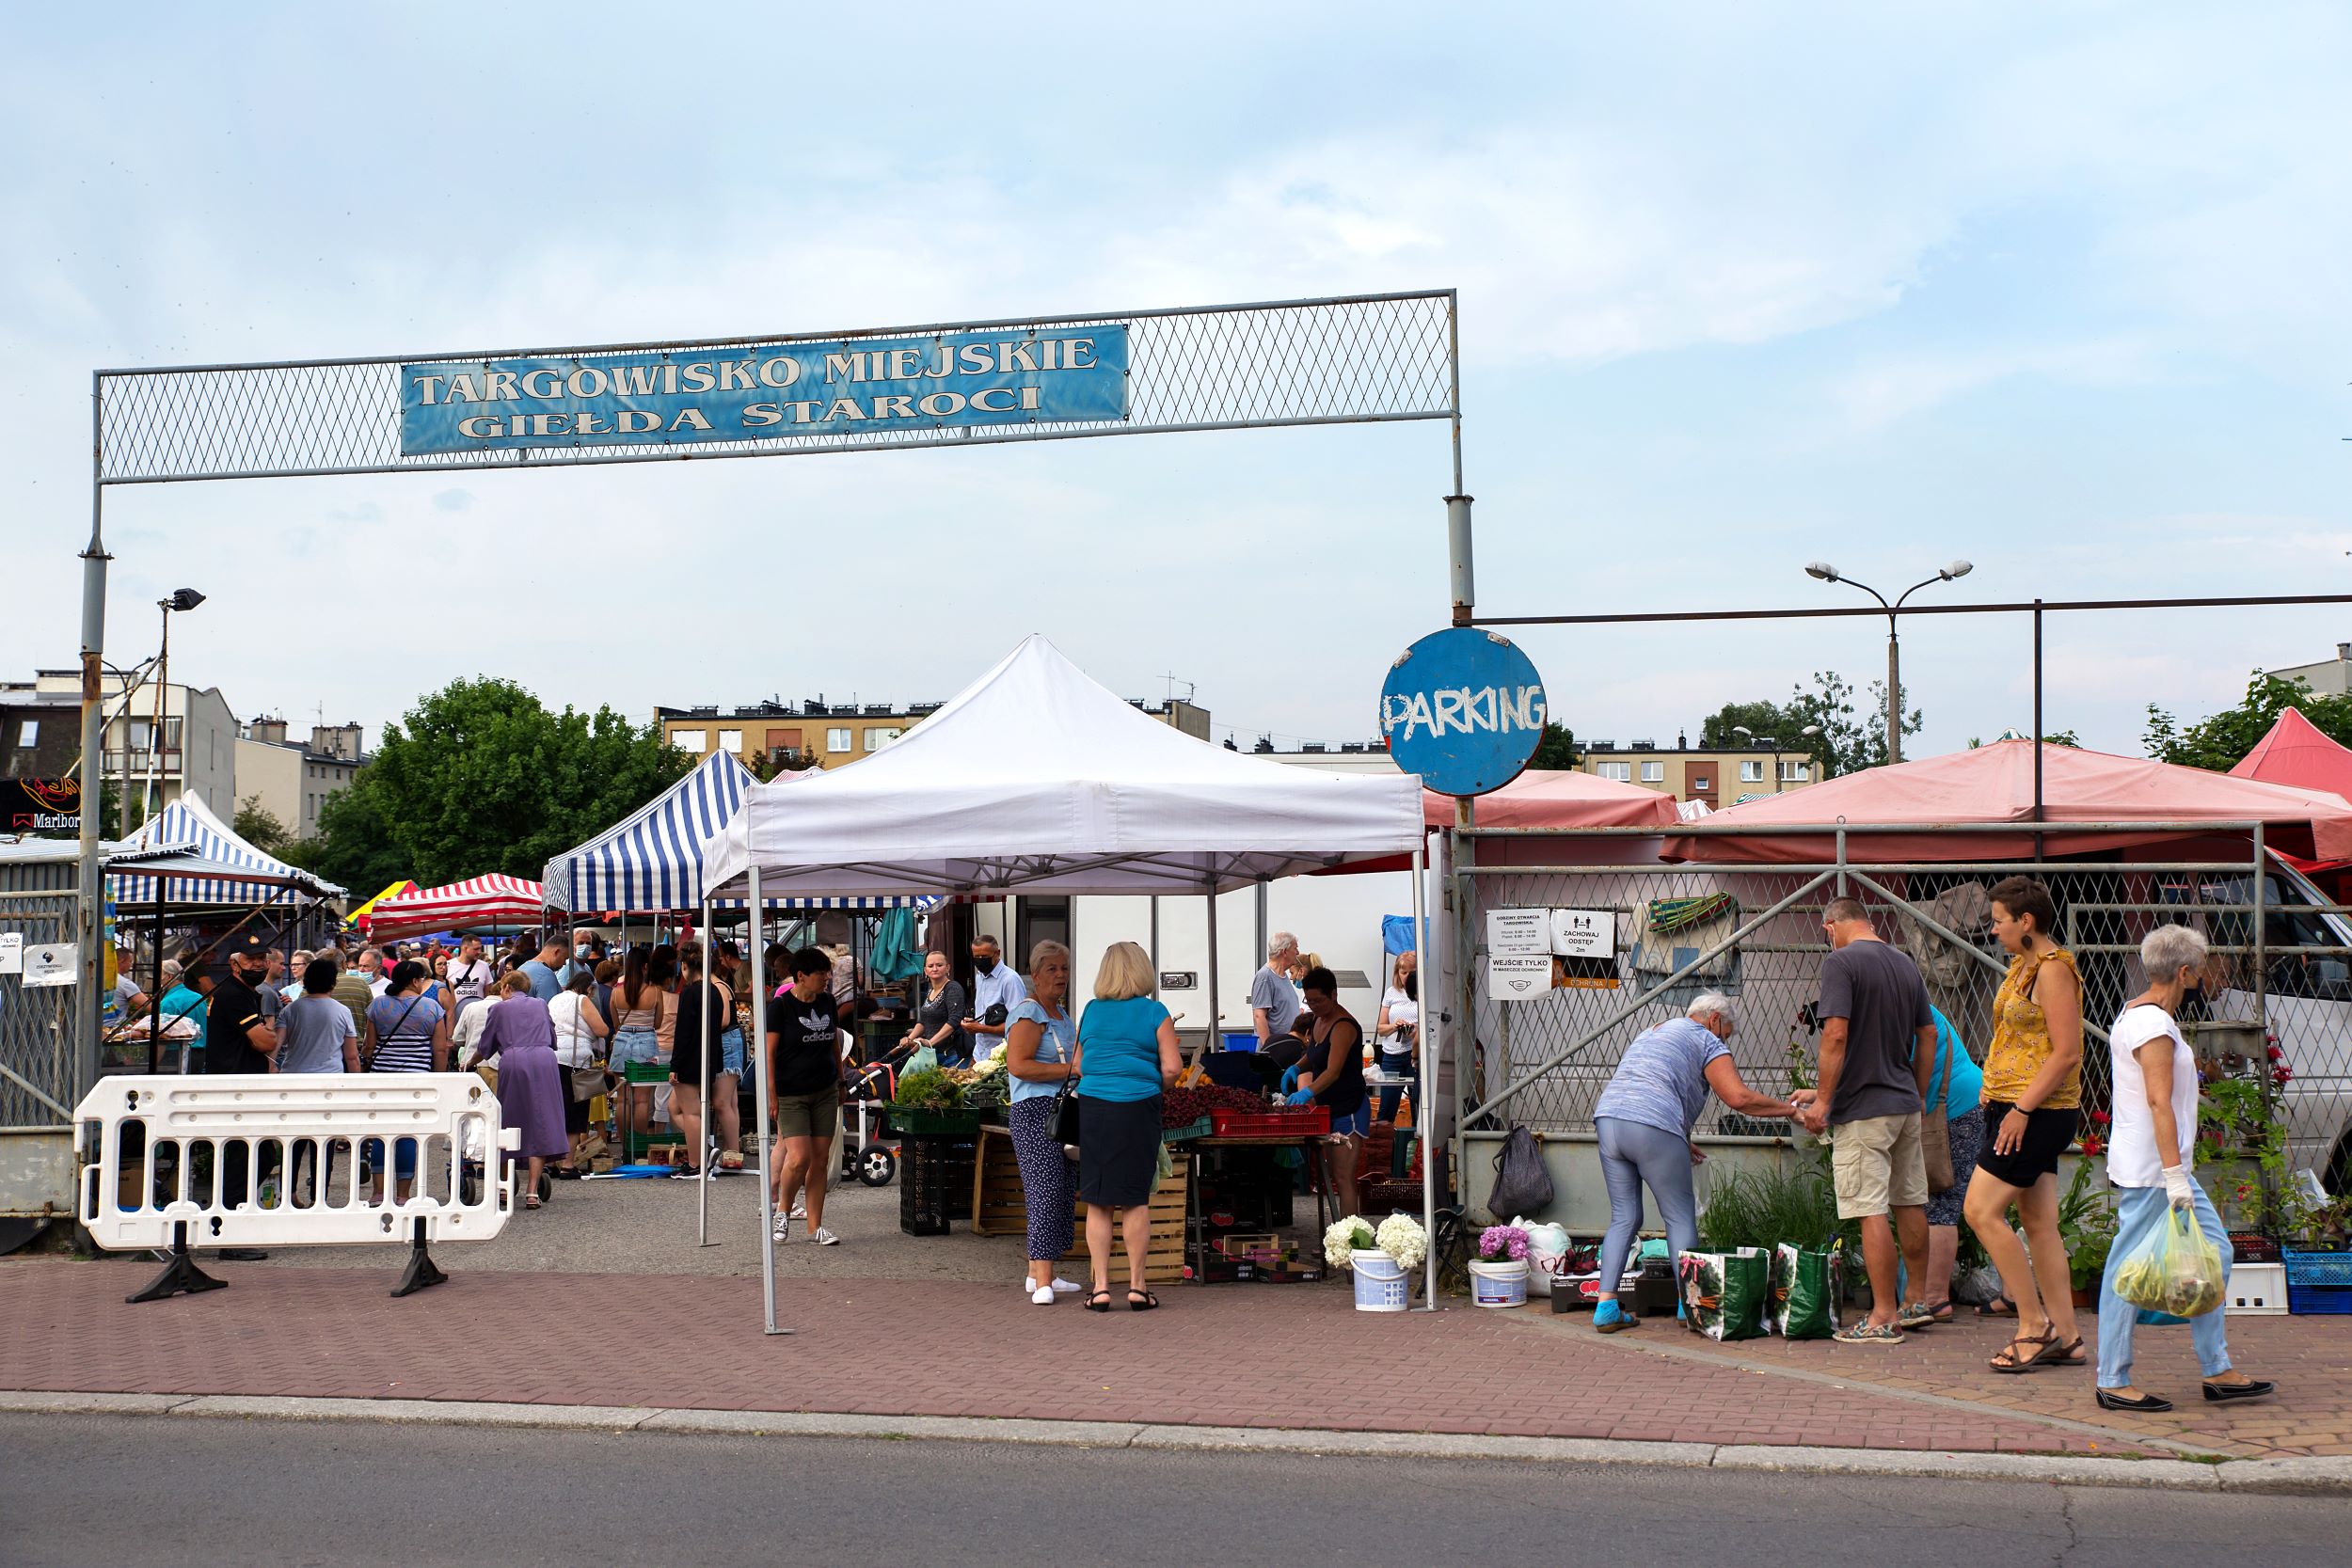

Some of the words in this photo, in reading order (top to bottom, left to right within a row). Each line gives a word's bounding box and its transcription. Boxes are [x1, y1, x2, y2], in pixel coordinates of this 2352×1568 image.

[412, 356, 801, 405] TARGOWISKO
[824, 338, 1099, 384] MIEJSKIE
[458, 408, 715, 438] GIEŁDA
[741, 387, 1041, 428] STAROCI
[1383, 685, 1547, 741] PARKING
[33, 813, 81, 828] Marlbor
[1567, 938, 1595, 946] ODSTĘP
[803, 1032, 835, 1042] adidas
